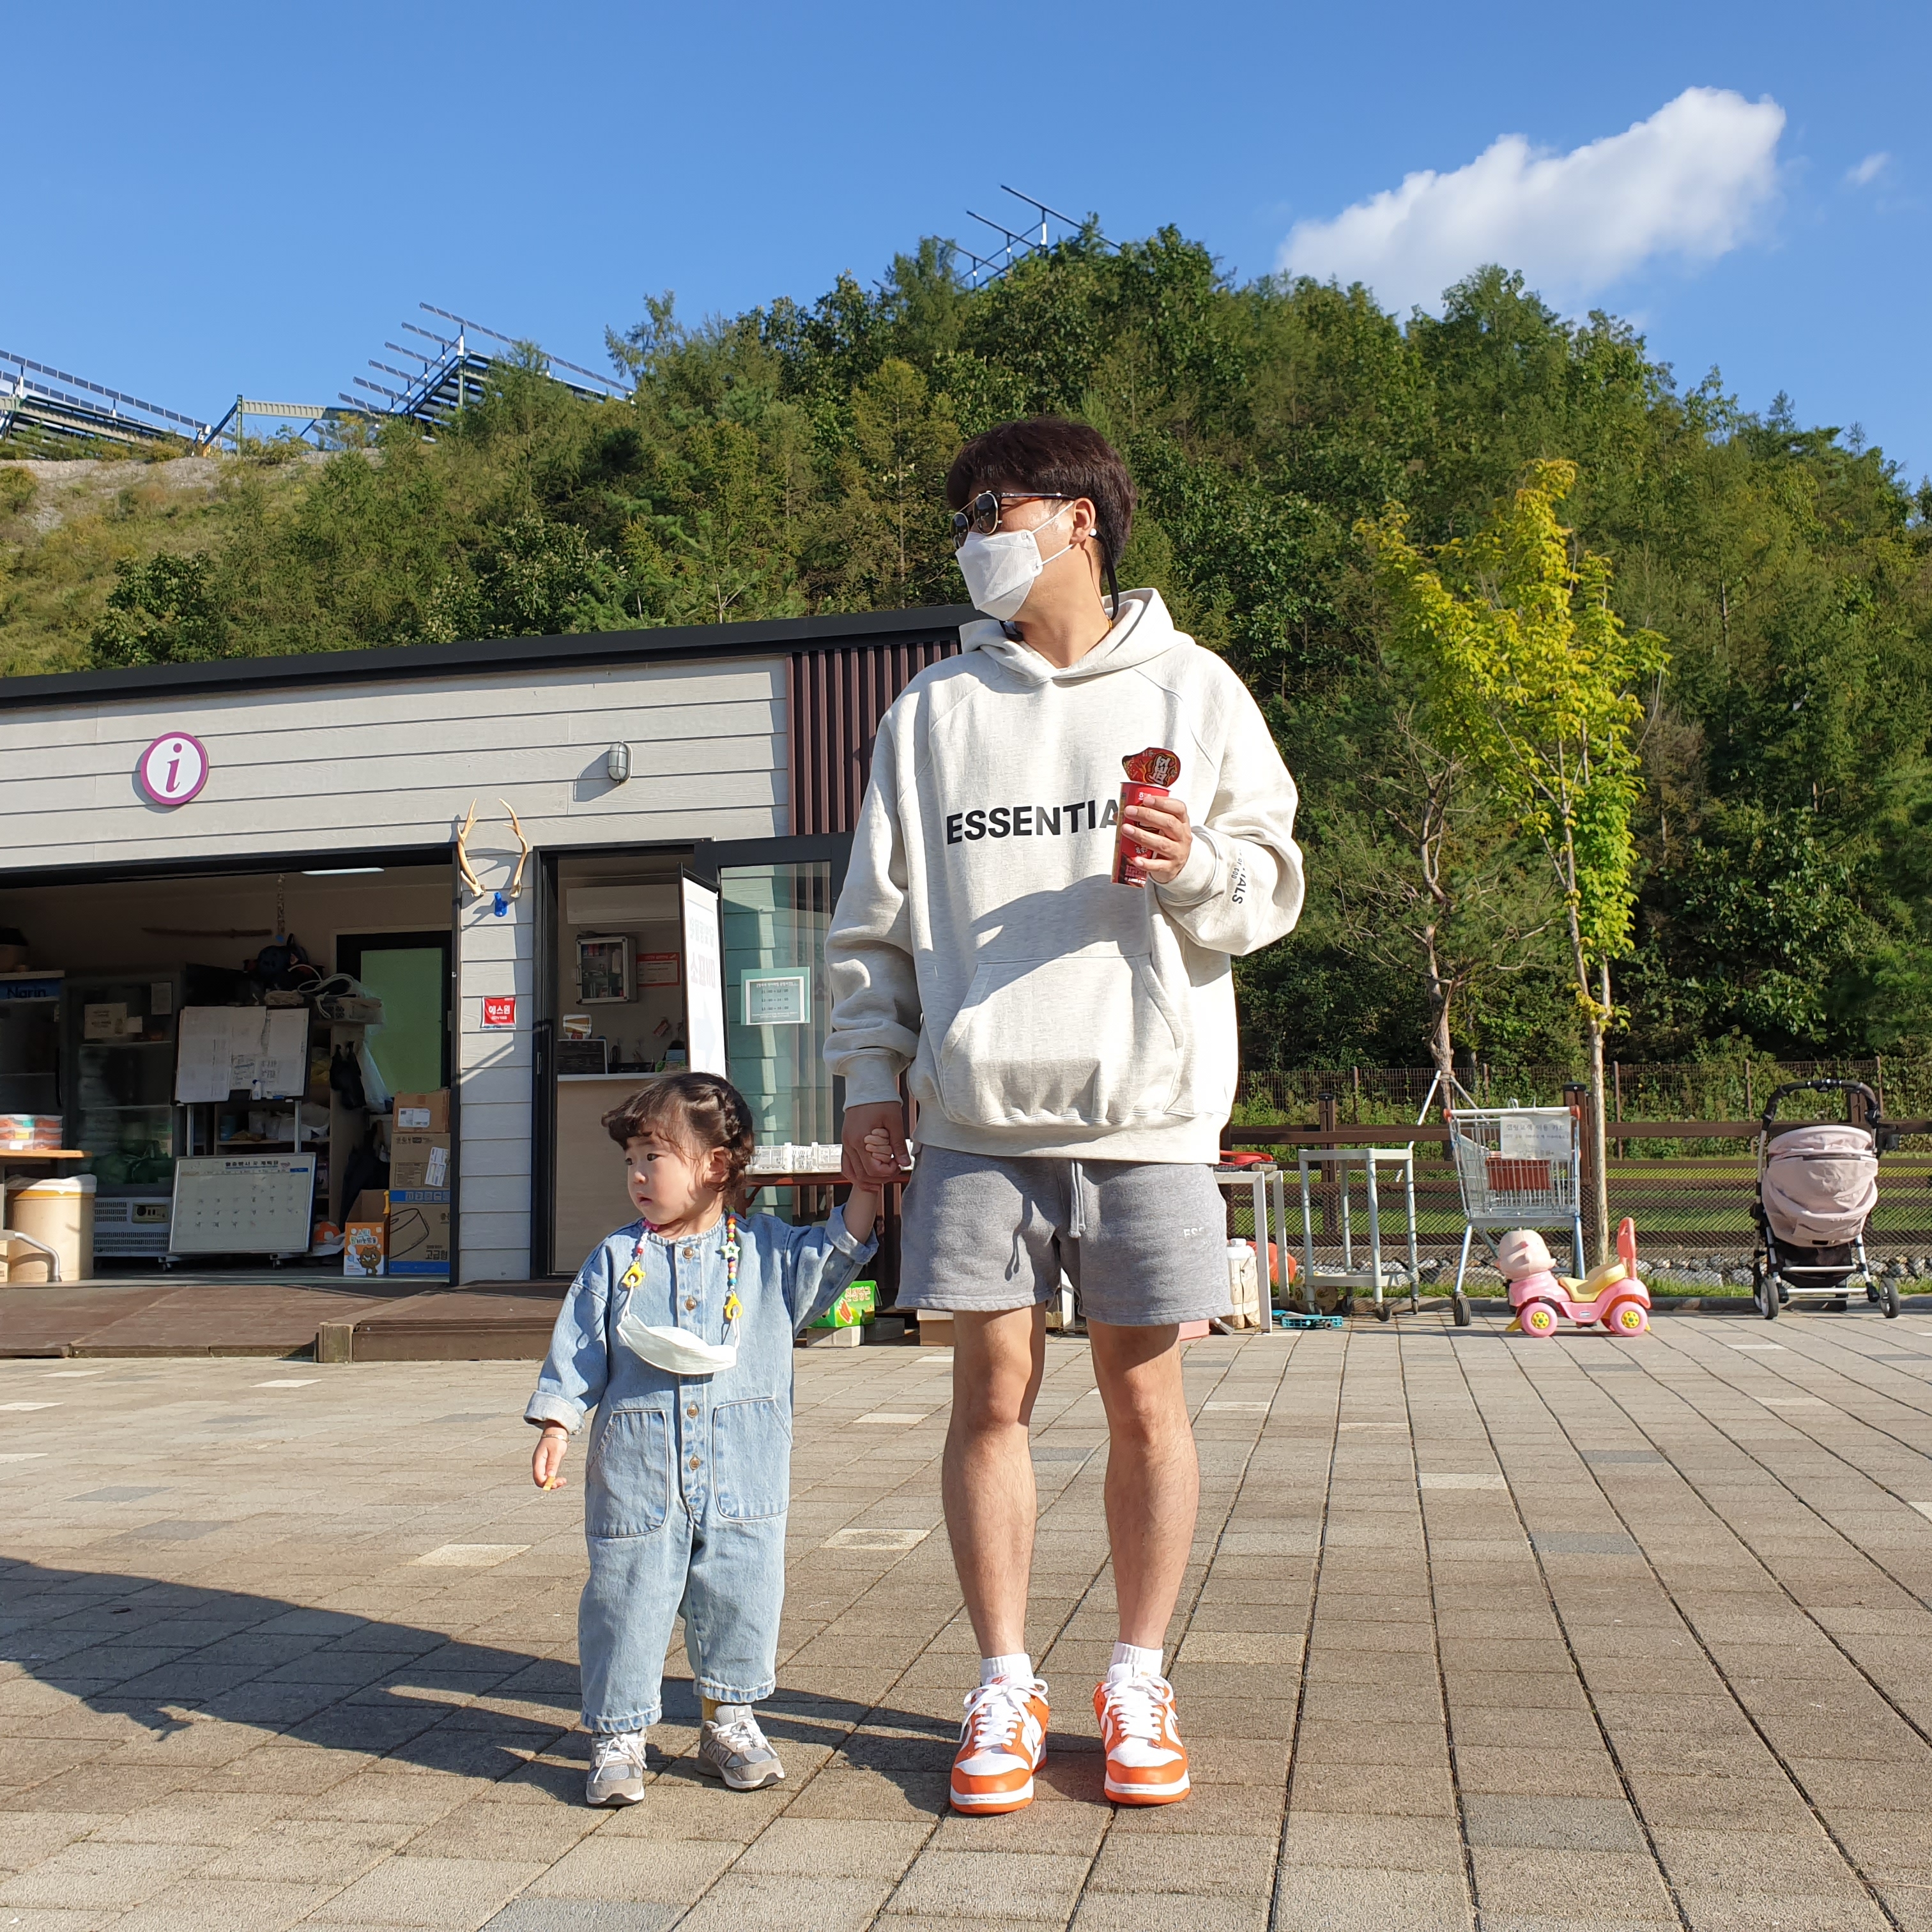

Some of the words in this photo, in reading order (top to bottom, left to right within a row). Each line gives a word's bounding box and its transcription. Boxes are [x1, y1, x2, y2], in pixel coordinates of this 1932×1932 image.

[946, 798, 1119, 845] ESSENTIA
[1231, 868, 1246, 905] IALS
[488, 1004, 510, 1015] 에스원
[425, 1250, 448, 1260] 고급형
